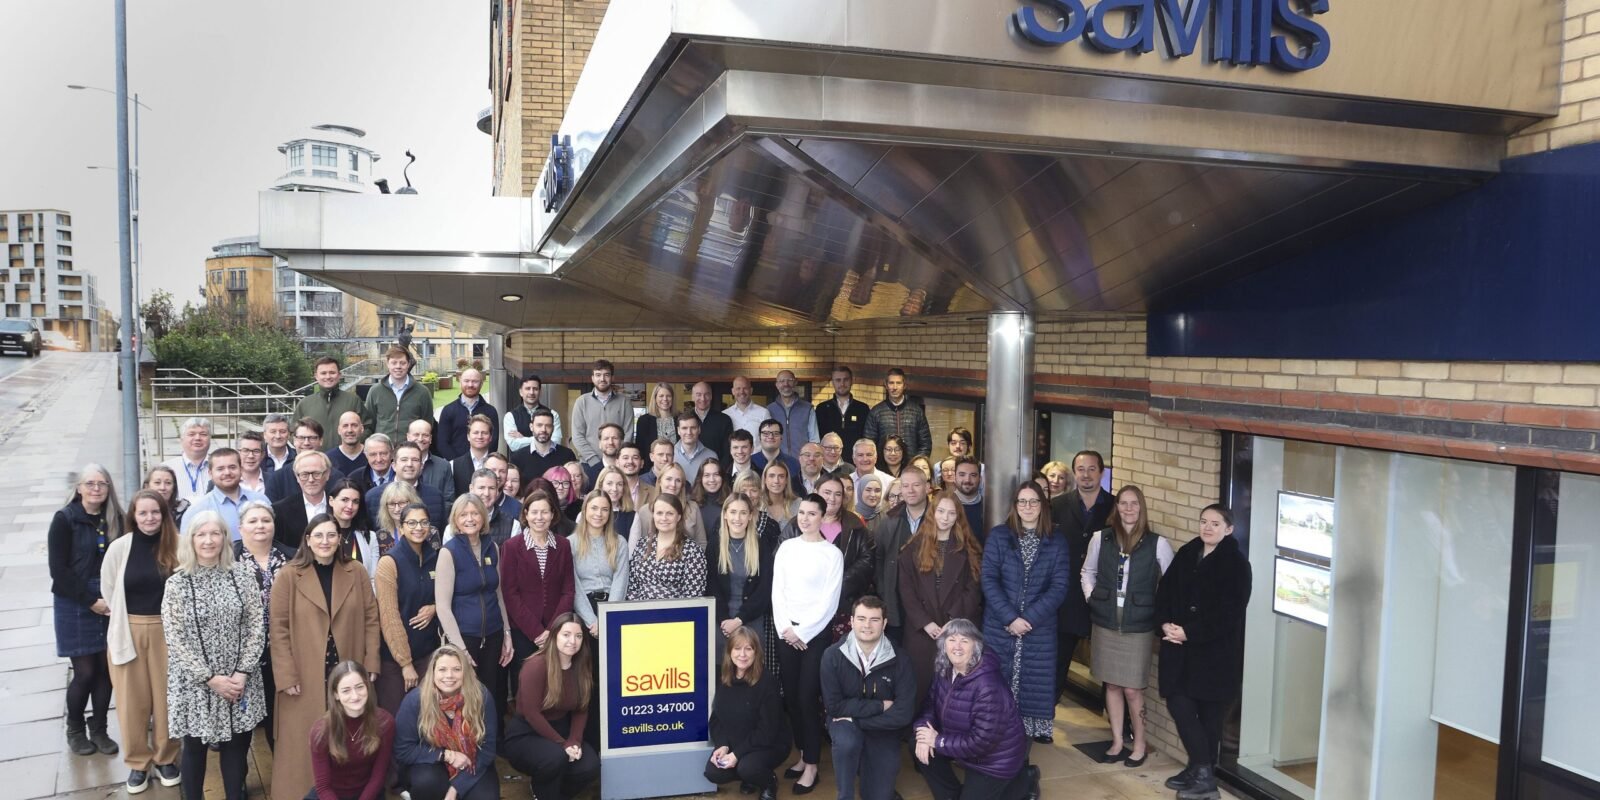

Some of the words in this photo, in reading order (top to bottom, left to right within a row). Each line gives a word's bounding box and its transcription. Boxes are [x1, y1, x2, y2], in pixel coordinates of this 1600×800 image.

[626, 667, 690, 692] savills
[621, 704, 654, 716] 01223
[656, 701, 695, 714] 347000
[621, 720, 684, 735] savills.co.uk
